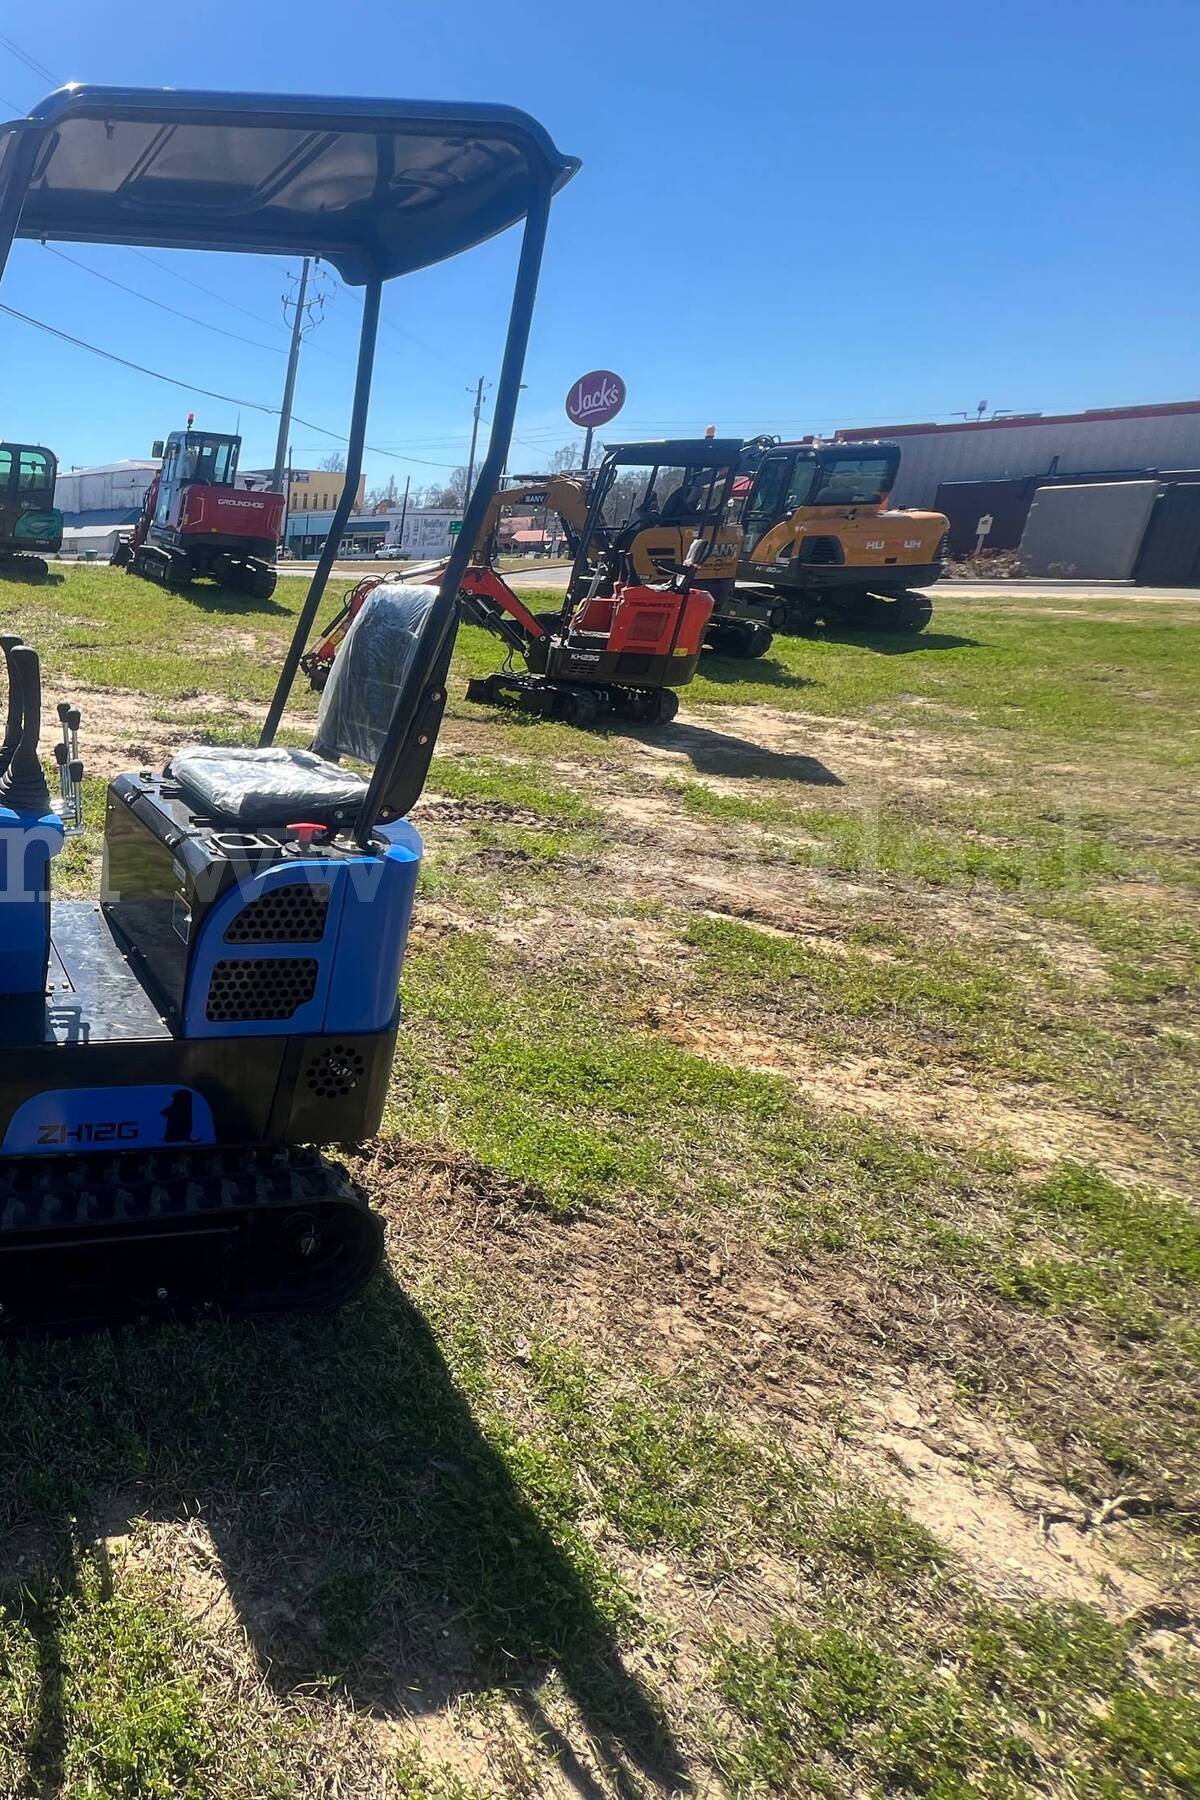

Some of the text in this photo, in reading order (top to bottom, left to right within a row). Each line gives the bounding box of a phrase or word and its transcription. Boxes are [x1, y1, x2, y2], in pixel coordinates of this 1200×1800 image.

[569, 378, 619, 416] Jack's
[217, 498, 265, 509] GROUNDHOG
[37, 1120, 140, 1145] ZH12G
